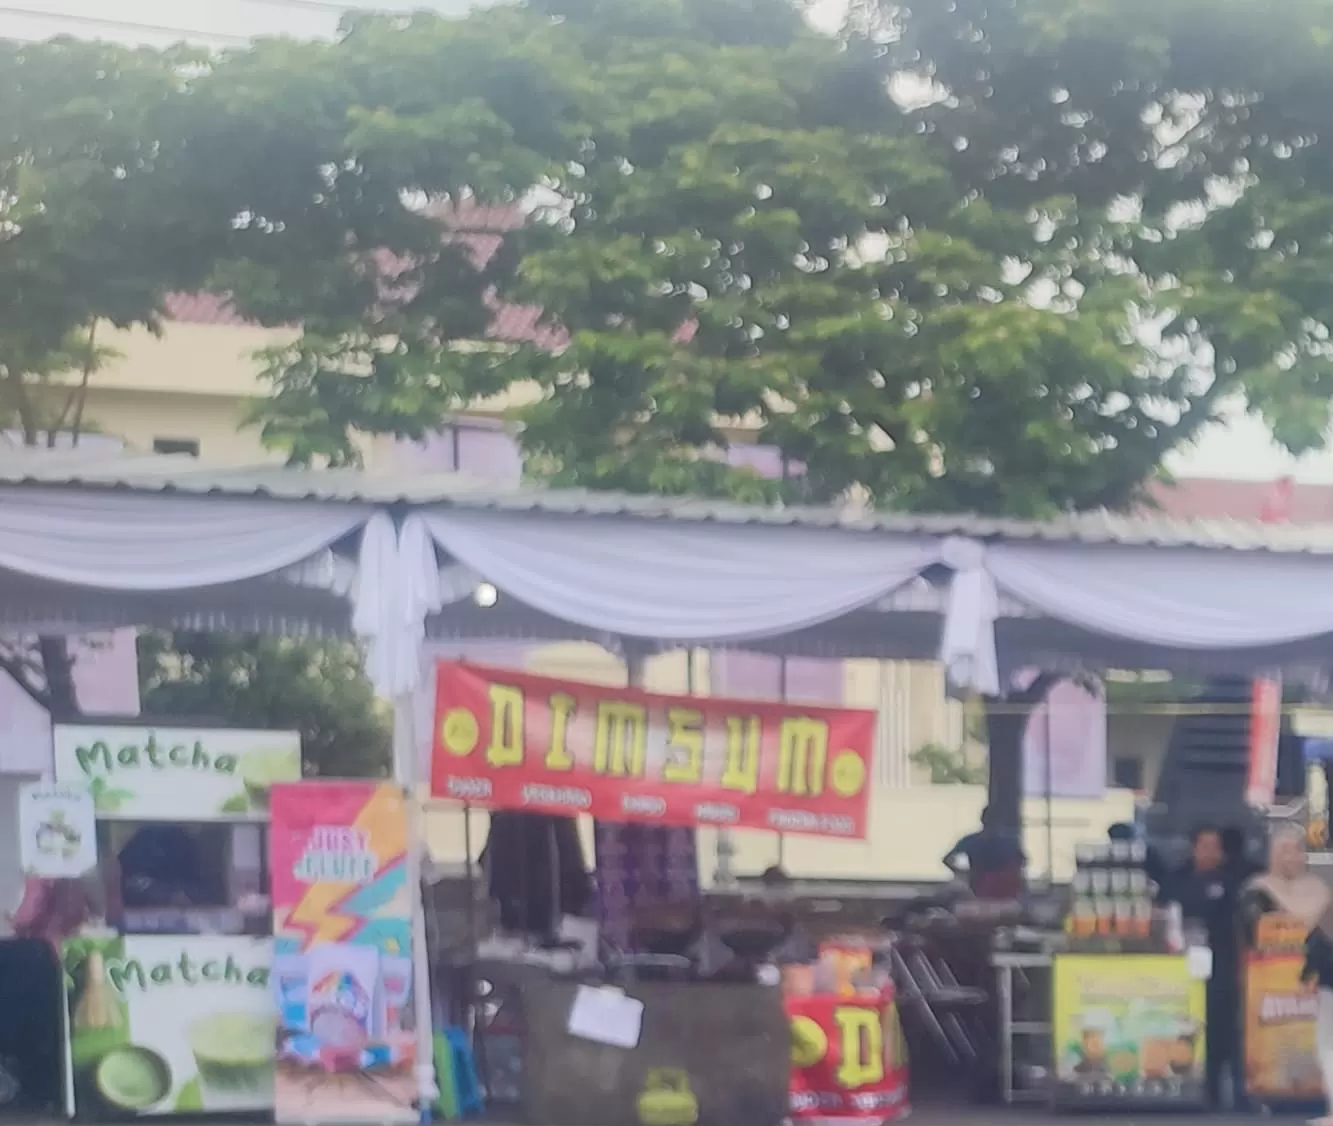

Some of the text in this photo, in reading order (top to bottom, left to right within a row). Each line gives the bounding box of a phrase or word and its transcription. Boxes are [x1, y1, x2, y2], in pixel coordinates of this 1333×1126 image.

[75, 730, 237, 774] Matcha
[485, 684, 829, 797] DIMSUM
[109, 953, 271, 992] Matcha
